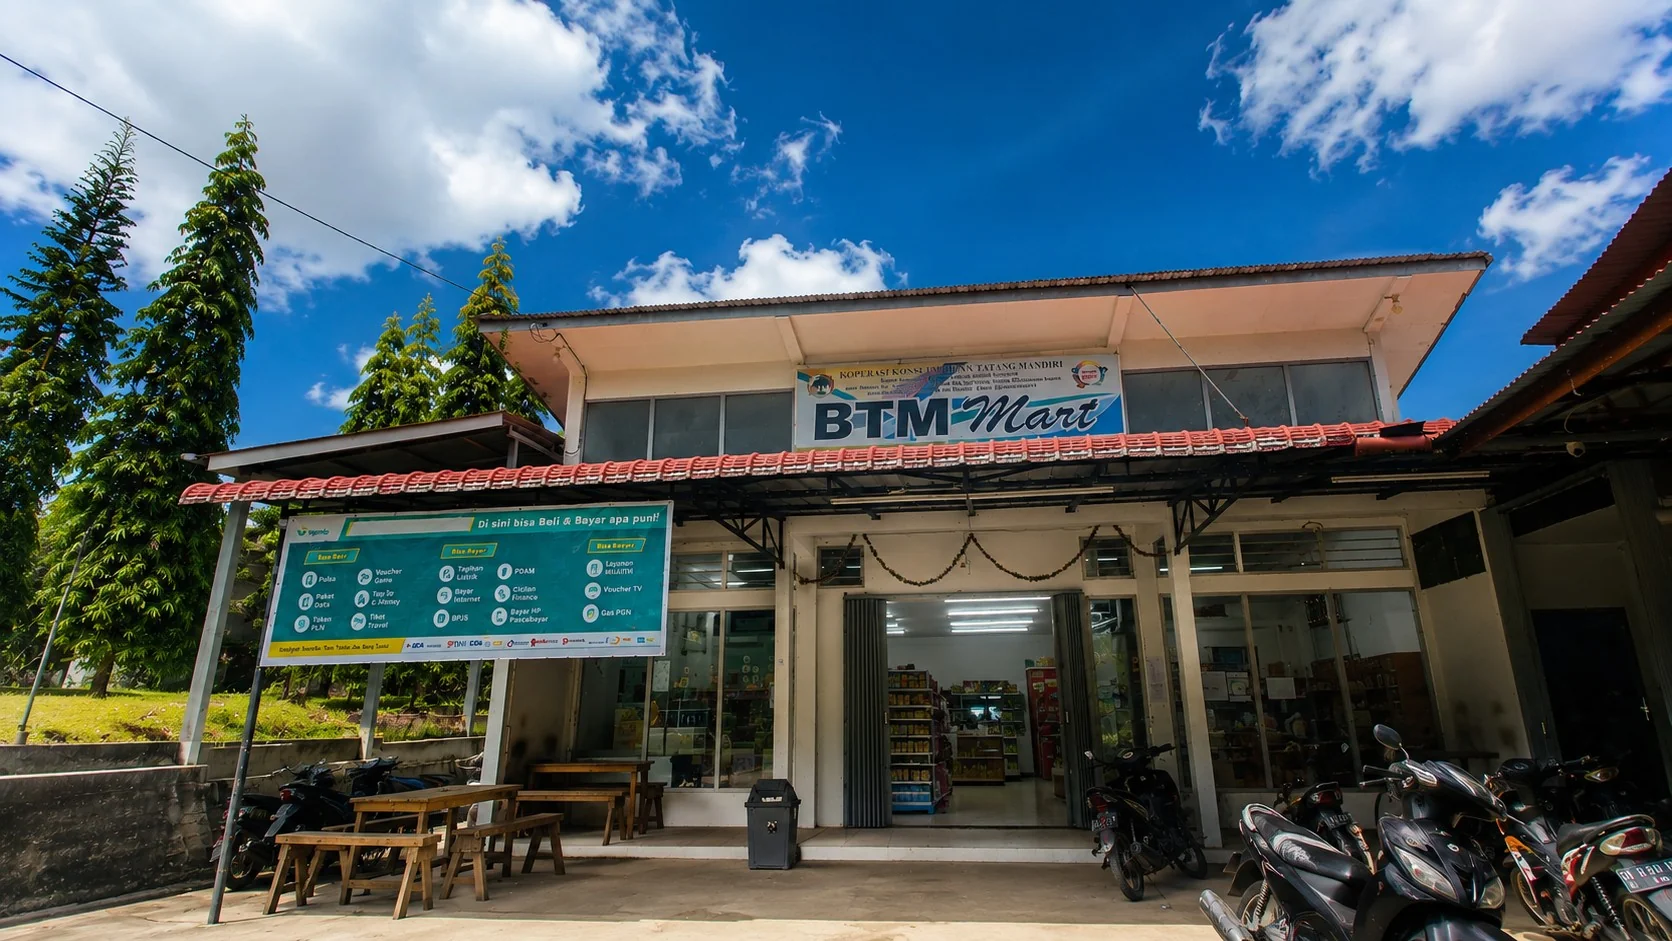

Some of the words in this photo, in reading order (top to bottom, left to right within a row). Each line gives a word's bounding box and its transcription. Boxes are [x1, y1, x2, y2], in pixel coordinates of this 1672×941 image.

[839, 369, 889, 379] KOPERASI
[974, 363, 1016, 372] TATANG
[1019, 360, 1063, 370] MANDIRI
[814, 398, 949, 440] BTM
[962, 395, 1098, 434] Mart
[478, 519, 488, 529] Di
[491, 518, 510, 528] sini
[513, 518, 535, 527] bisa
[538, 516, 560, 526] Beli
[563, 516, 571, 525] &
[575, 515, 606, 527] Bayar
[609, 516, 629, 526] apa
[375, 568, 403, 576] Voucher
[603, 585, 631, 593] Voucher
[632, 584, 643, 592] TV
[601, 609, 615, 617] Gas
[615, 608, 632, 616] PGN
